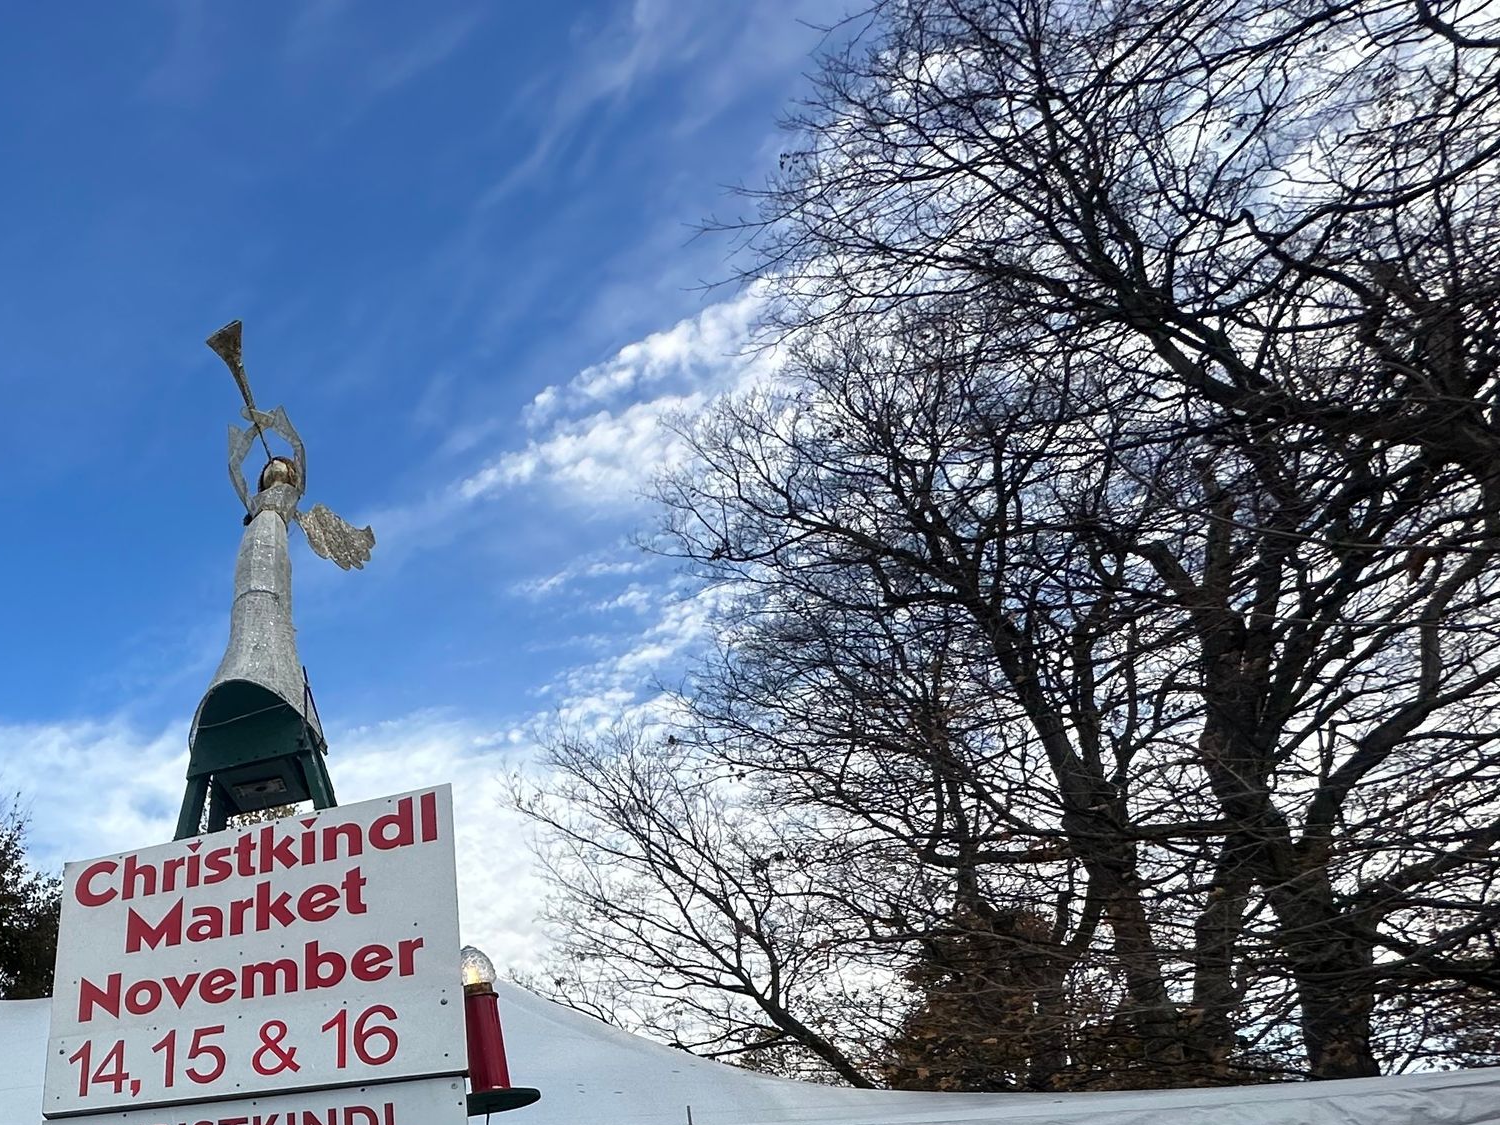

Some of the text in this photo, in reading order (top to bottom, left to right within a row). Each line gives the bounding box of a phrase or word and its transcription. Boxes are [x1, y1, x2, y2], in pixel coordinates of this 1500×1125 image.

[75, 792, 437, 907] Christkindl
[125, 866, 367, 954] Market
[78, 937, 424, 1023] November
[251, 1020, 300, 1075] &
[322, 1004, 398, 1069] 16
